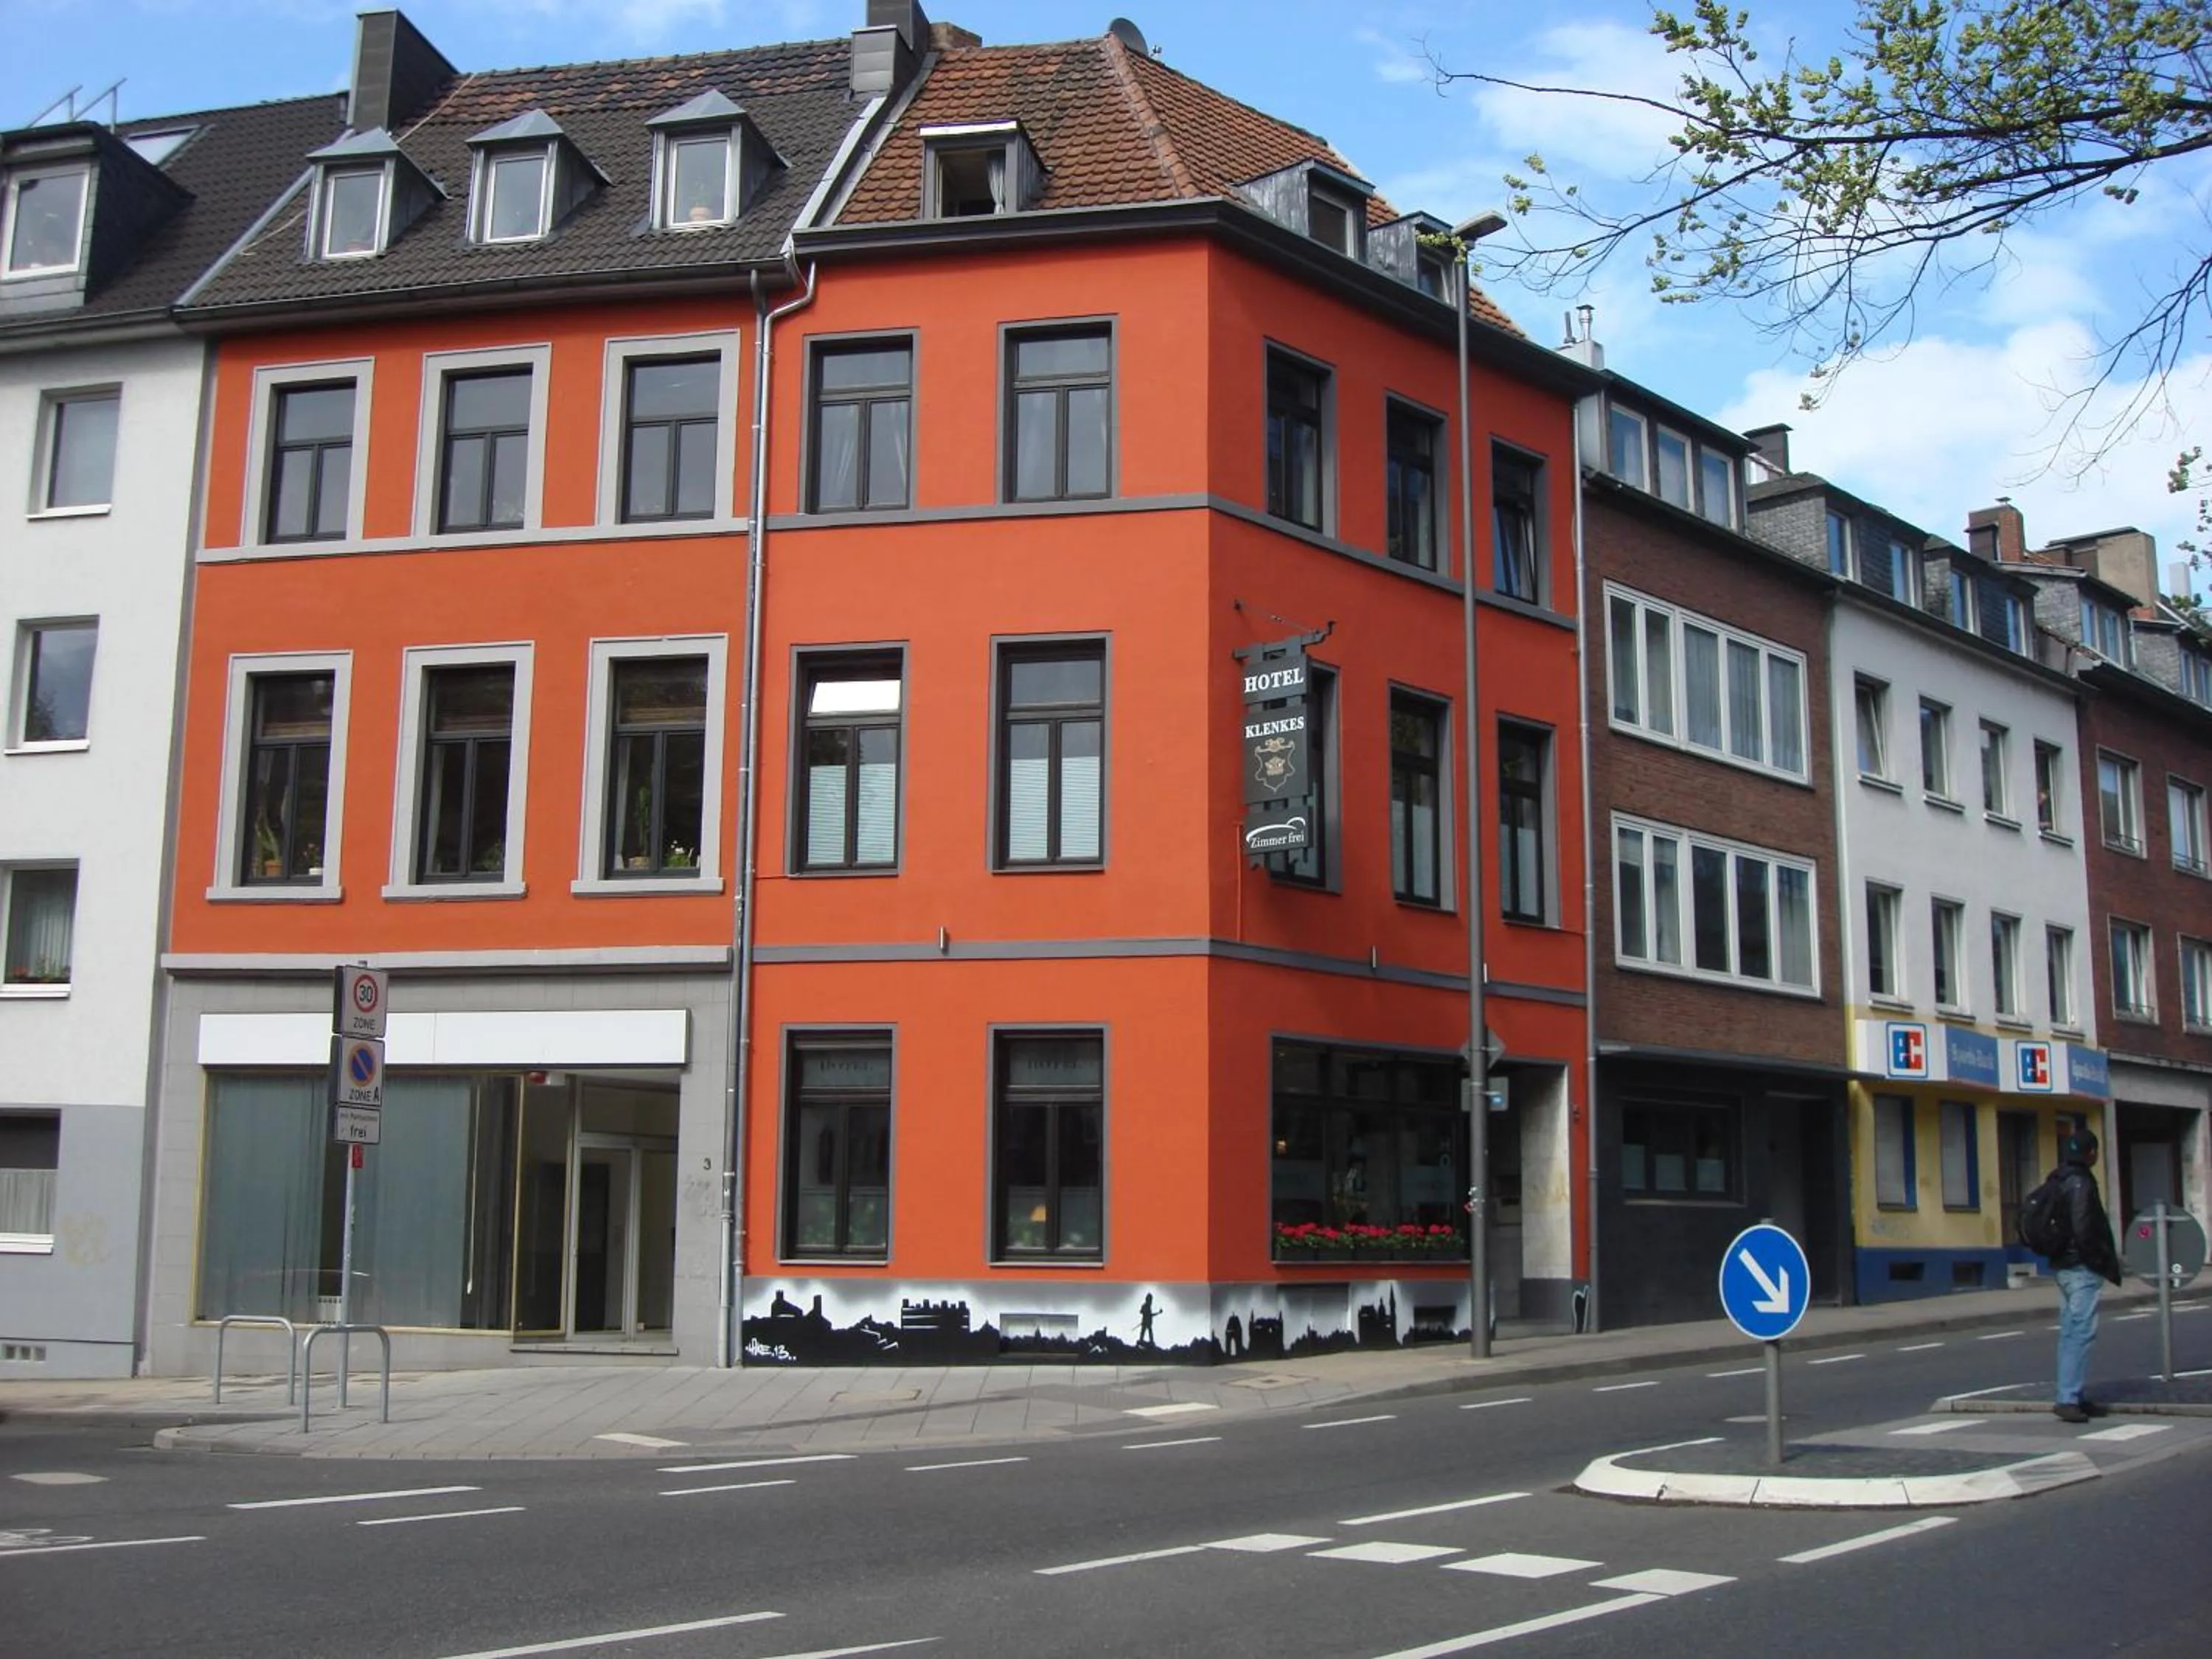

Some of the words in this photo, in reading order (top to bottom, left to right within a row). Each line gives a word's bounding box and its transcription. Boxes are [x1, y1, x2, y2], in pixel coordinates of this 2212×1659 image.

[1244, 667, 1304, 693] HOTEL
[1245, 716, 1304, 739] KLENKES
[1250, 835, 1287, 849] Zimmer
[1288, 830, 1304, 843] frei
[359, 984, 374, 1003] 30
[353, 1017, 375, 1030] ZONE
[349, 1088, 372, 1102] ZONE
[374, 1086, 380, 1102] A
[350, 1124, 366, 1138] frei
[703, 1158, 712, 1170] 3
